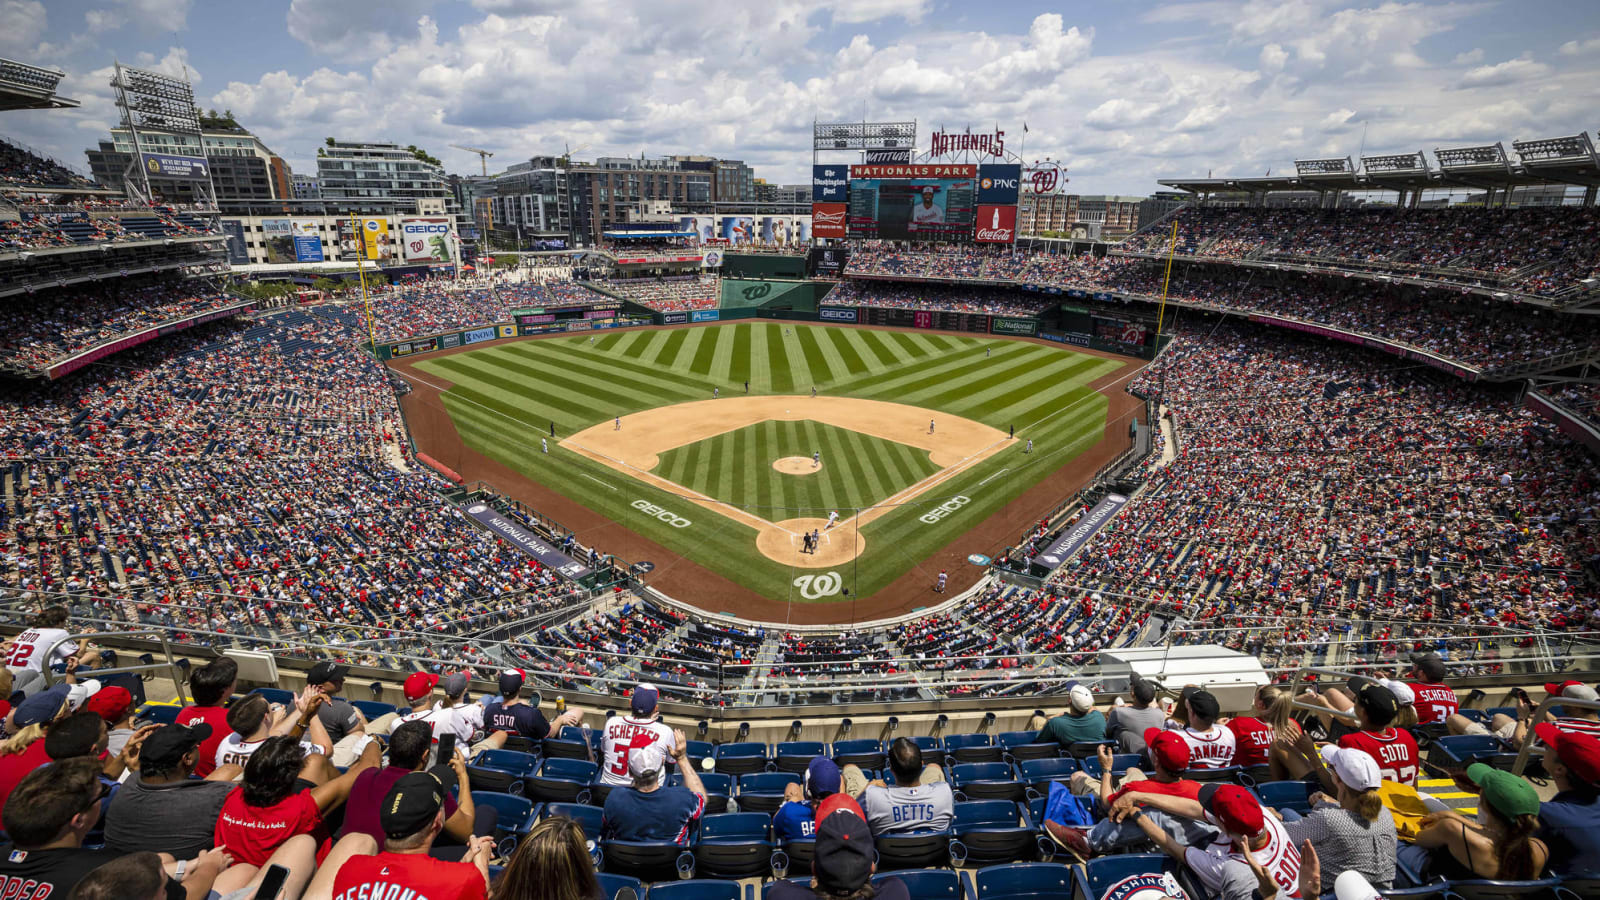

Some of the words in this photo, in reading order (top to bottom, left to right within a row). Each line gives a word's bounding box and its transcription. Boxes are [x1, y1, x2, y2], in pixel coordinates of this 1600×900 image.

[931, 131, 1005, 157] NATIONALS
[866, 151, 910, 162] NATITUDE
[855, 167, 928, 176] NATIONALS
[934, 168, 969, 176] PARK
[814, 178, 846, 186] Washington
[994, 179, 1018, 188] PNC
[823, 187, 836, 196] Post
[405, 225, 448, 233] GEICO
[977, 228, 1012, 240] Coca-Cola
[821, 310, 855, 319] GEICO
[1004, 322, 1033, 330] National
[472, 330, 494, 340] INOVA
[630, 499, 692, 529] GEICO
[919, 495, 972, 525] GEICO
[1052, 523, 1093, 556] WASHINGTON
[1088, 502, 1117, 526] NATIONALS
[489, 517, 530, 544] NATIONALS
[526, 540, 550, 556] PARK
[18, 632, 40, 643] SOTO
[493, 714, 515, 727] SOTO
[1380, 744, 1409, 764] SOTO
[892, 804, 934, 822] BETTS
